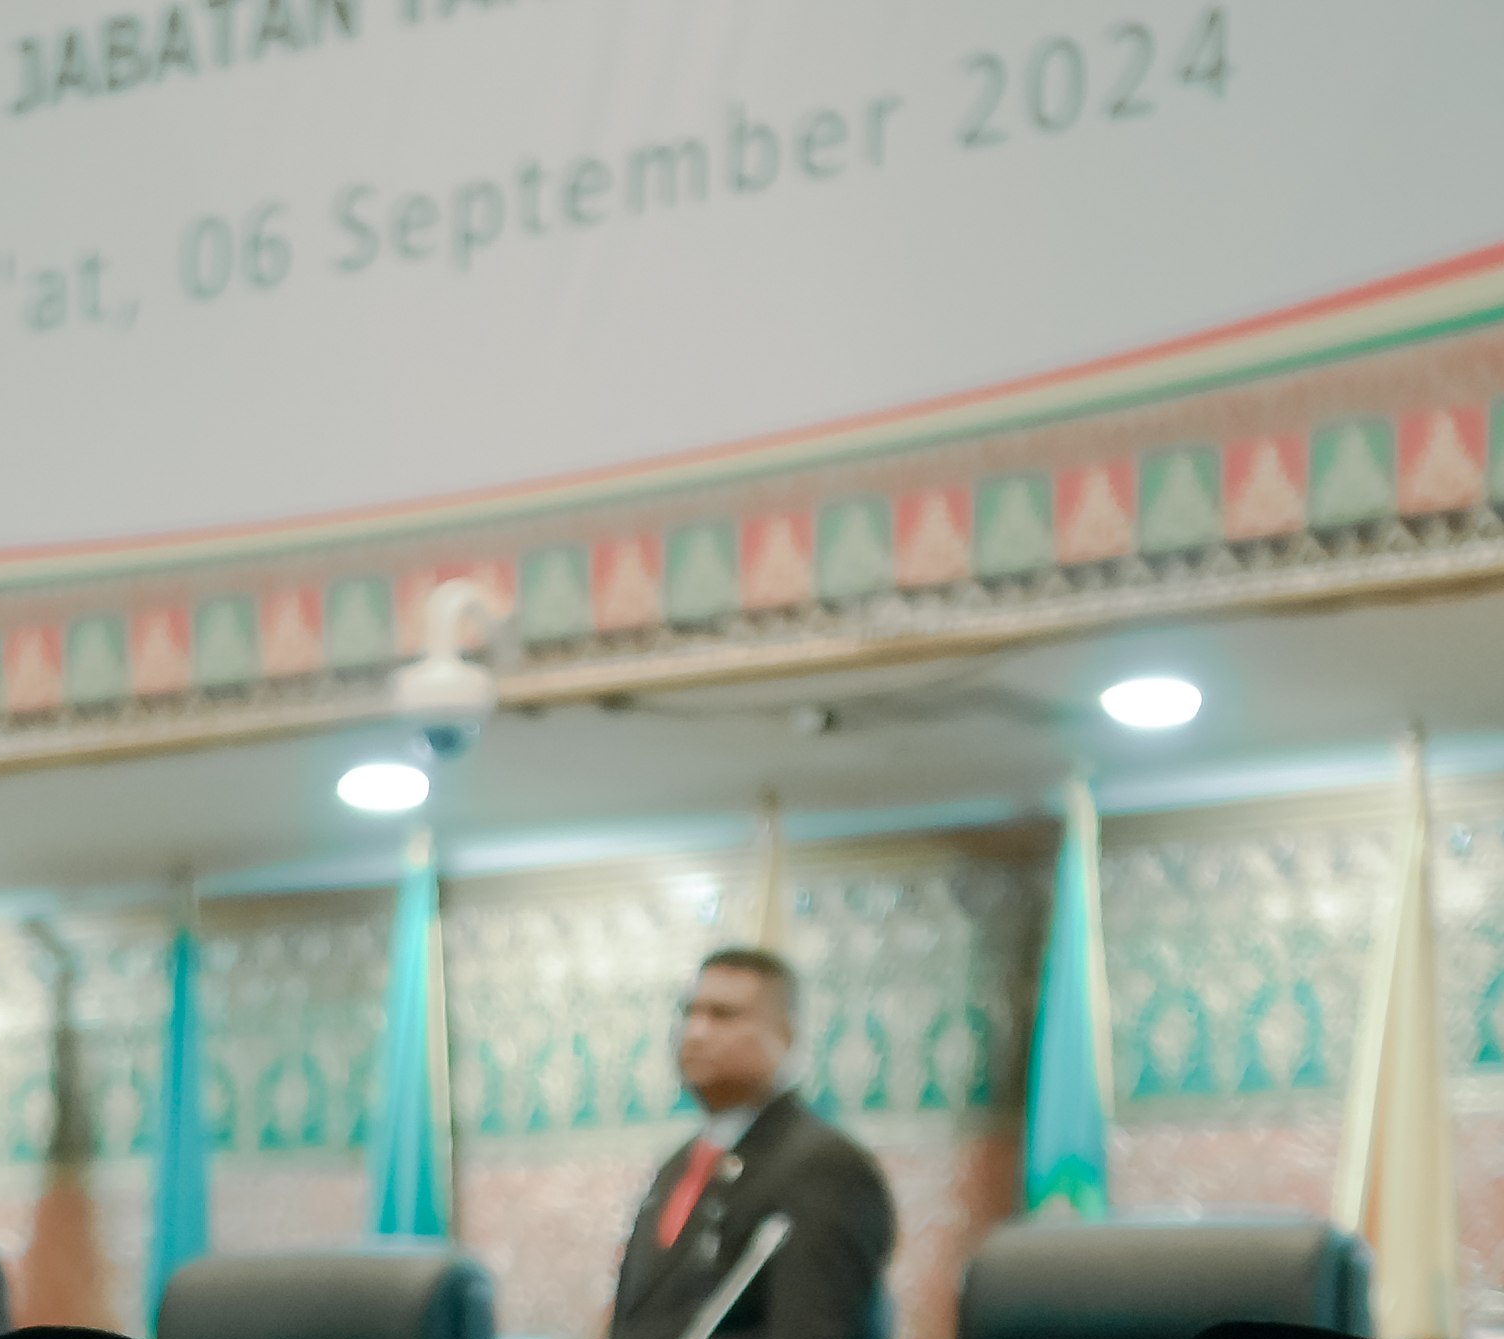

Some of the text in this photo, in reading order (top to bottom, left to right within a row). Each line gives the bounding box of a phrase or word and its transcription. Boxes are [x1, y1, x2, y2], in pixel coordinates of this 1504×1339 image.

[8, 0, 358, 116] JABATAN
[176, 200, 292, 305] 06
[331, 94, 902, 275] September
[954, 4, 1234, 152] 2024
